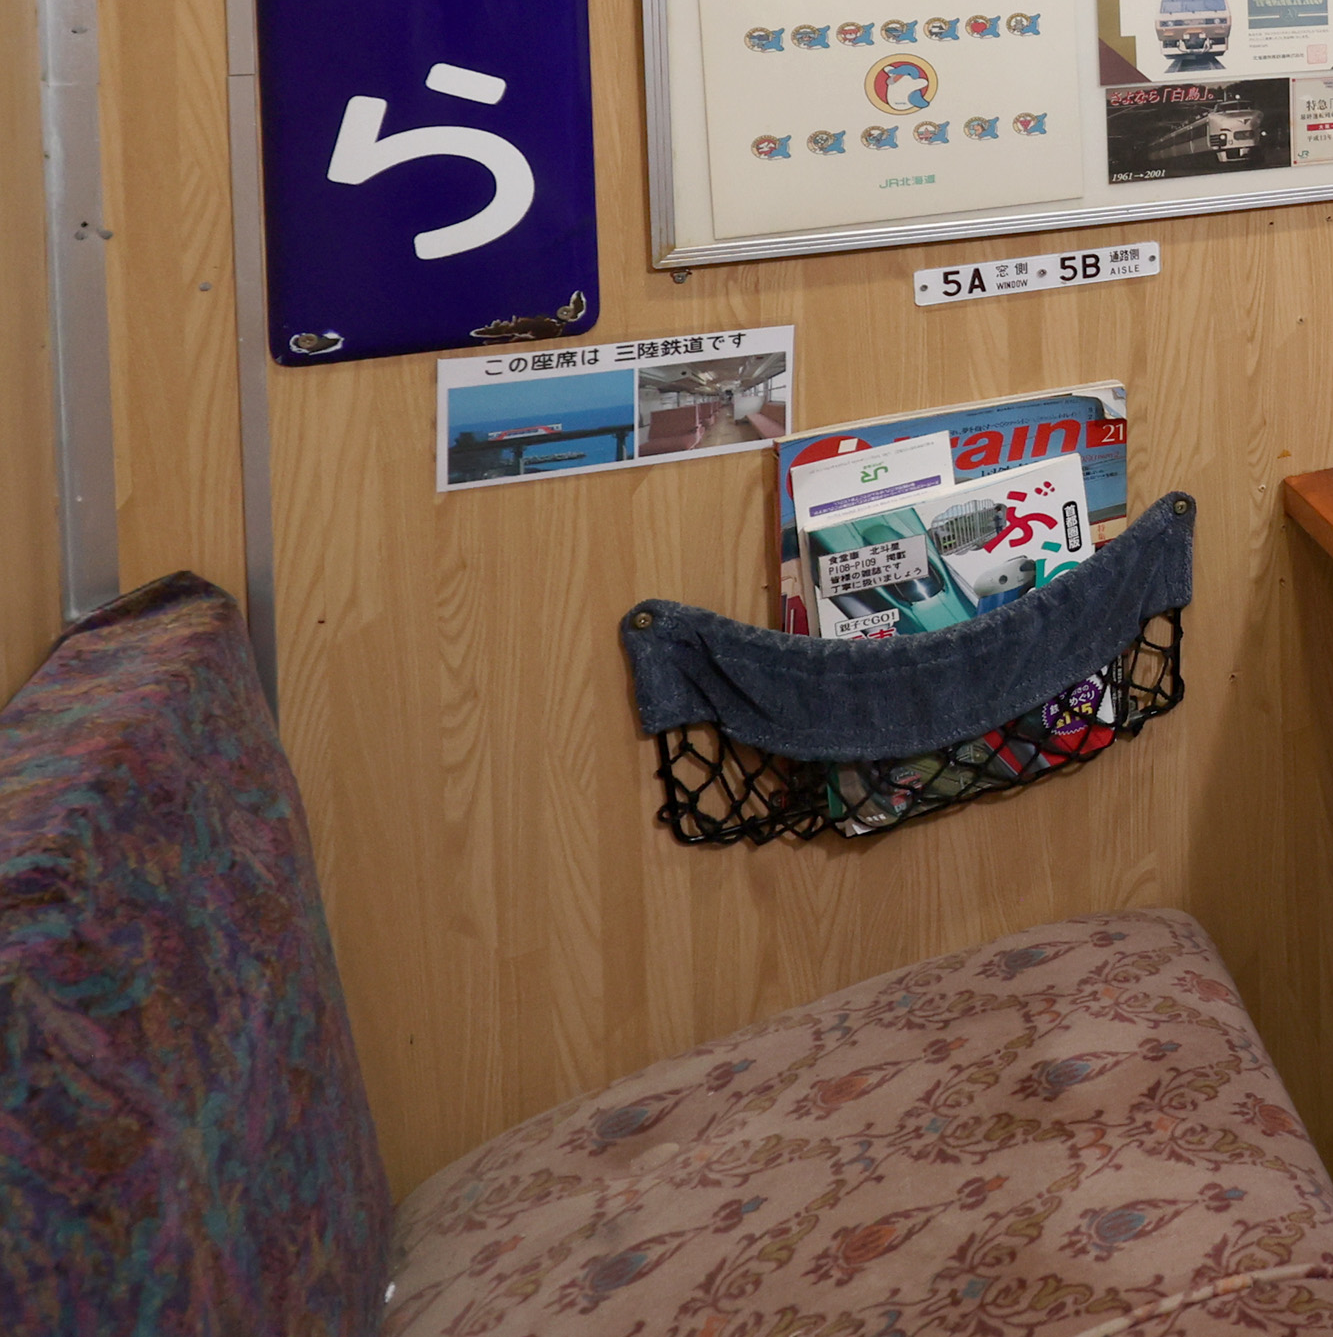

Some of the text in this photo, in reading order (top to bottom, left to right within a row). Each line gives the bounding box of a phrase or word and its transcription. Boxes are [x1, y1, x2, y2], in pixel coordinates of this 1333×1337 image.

[1109, 87, 1214, 106] さよなら「白鳥」。
[1298, 150, 1309, 159] JR
[879, 174, 936, 189] JR北海道
[1109, 248, 1140, 263] 通路側
[1059, 253, 1101, 282] 5B
[1110, 264, 1141, 275] AISLE
[942, 267, 987, 297] 5A
[996, 279, 1028, 290] WINDOW
[484, 331, 747, 376] この座席は 三陸鉄道です
[1101, 423, 1124, 443] 21
[951, 419, 1082, 471] ain
[1066, 504, 1081, 550] 首都圏版
[828, 542, 900, 565] 食堂車 北斗星
[828, 550, 907, 576] P108-P109 掲載
[830, 562, 903, 585] 皆様の雑誌です
[831, 566, 923, 594] 丁寧に扱いましょう
[838, 611, 897, 633] 親子でGO!
